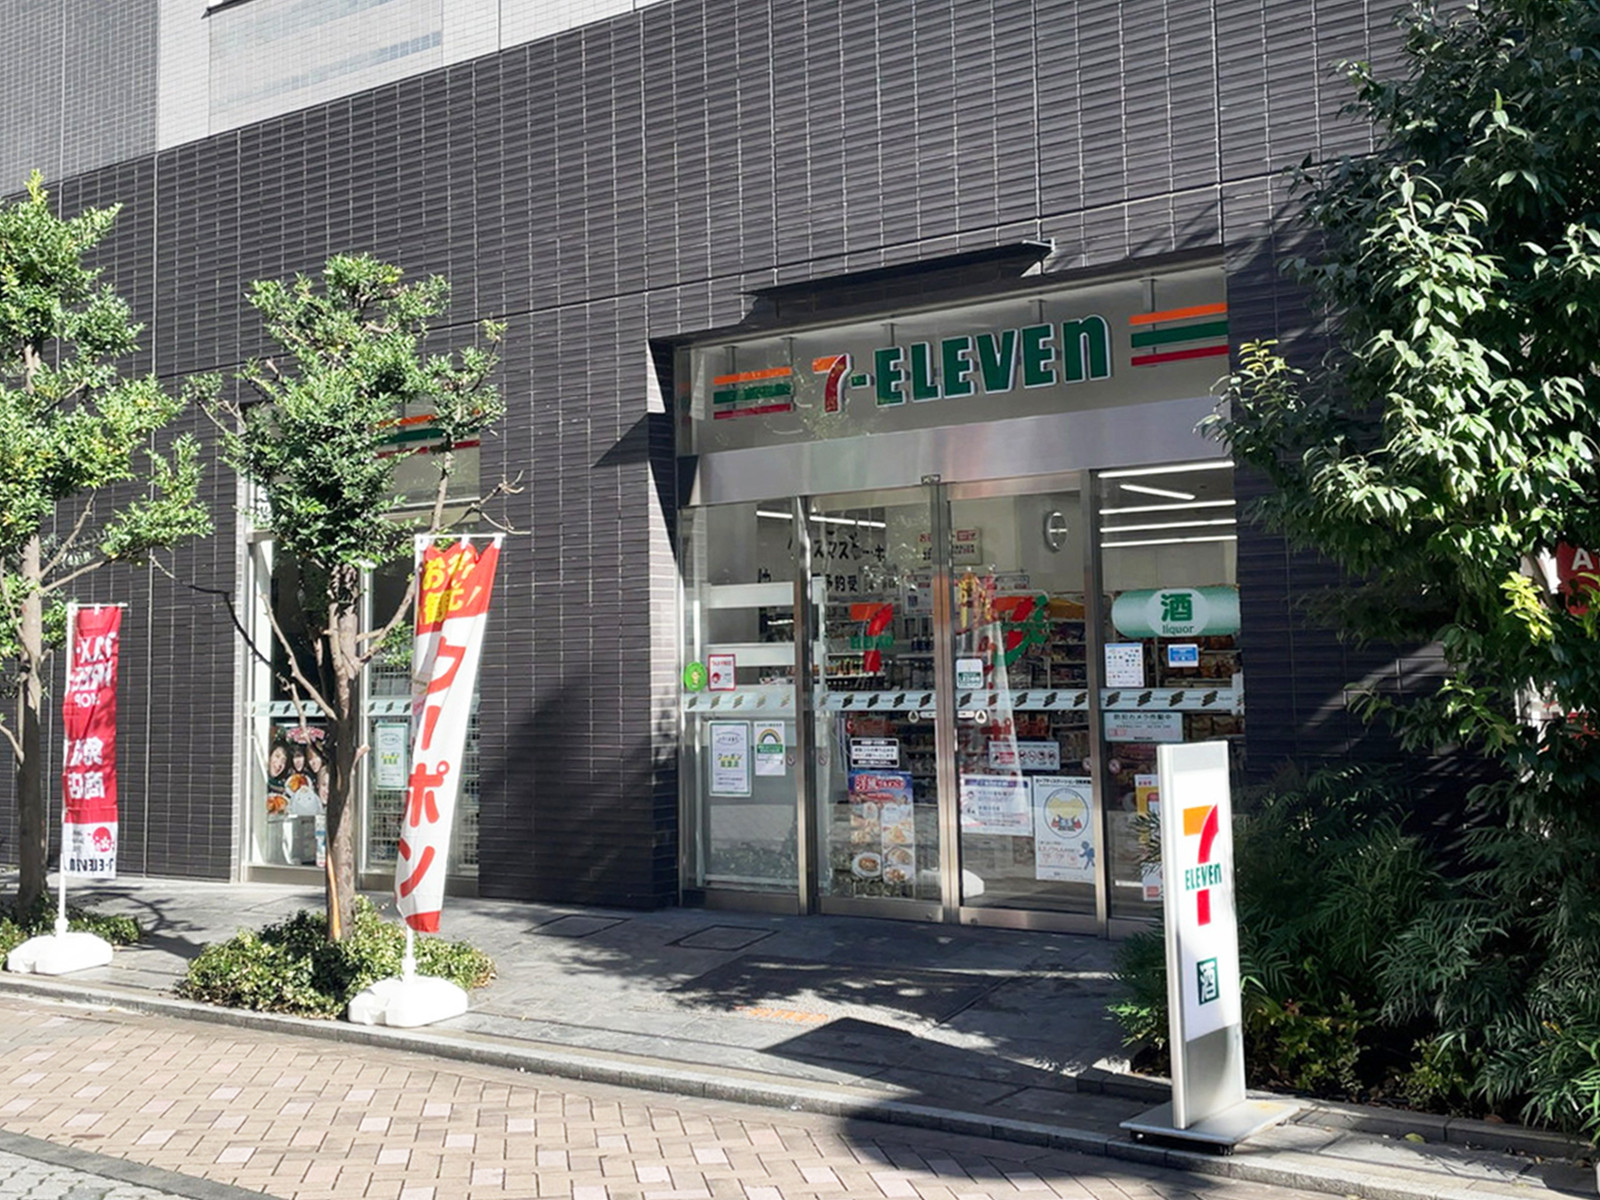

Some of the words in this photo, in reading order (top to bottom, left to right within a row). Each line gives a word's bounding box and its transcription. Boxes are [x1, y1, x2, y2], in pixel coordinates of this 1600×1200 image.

[1571, 547, 1600, 571] A
[1160, 593, 1193, 622] 酒
[1162, 624, 1194, 635] liquor
[398, 634, 468, 899] クーポン
[1199, 960, 1217, 1003] 酒
